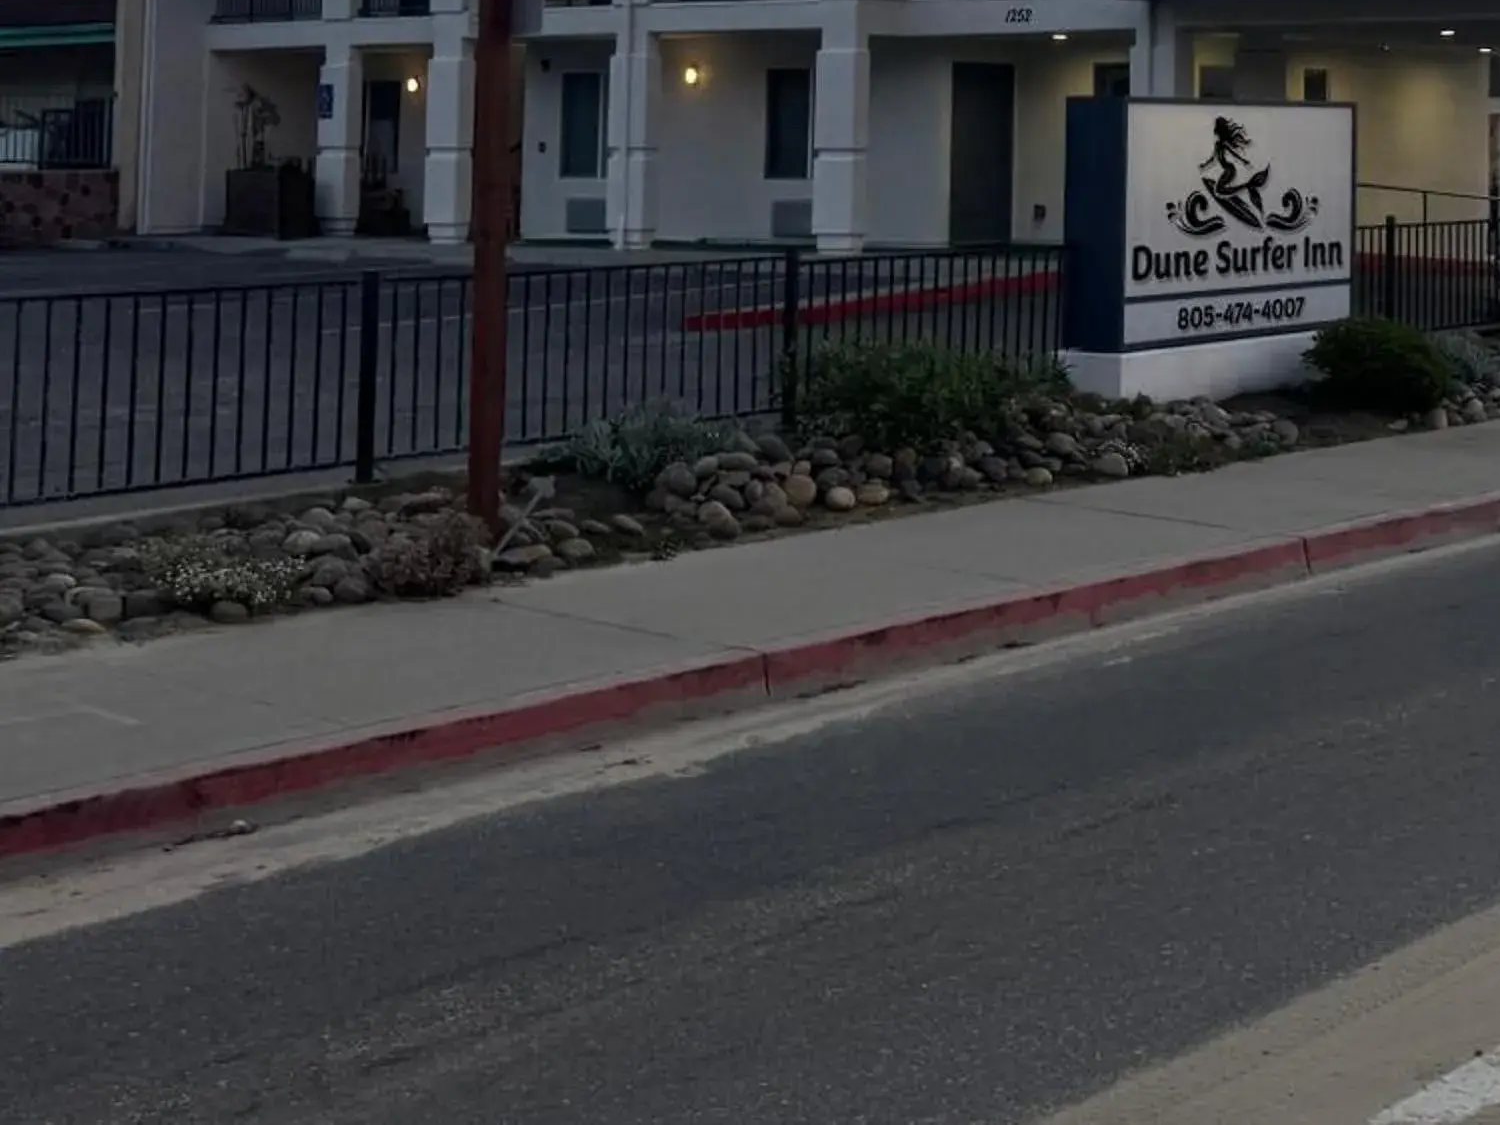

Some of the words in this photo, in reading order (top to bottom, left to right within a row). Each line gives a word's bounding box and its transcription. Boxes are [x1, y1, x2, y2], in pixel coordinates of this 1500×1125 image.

[1131, 245, 1209, 281] Dune
[1215, 236, 1297, 273] Surfer
[1303, 236, 1343, 268] Inn
[1177, 297, 1305, 330] 805-474-4007
